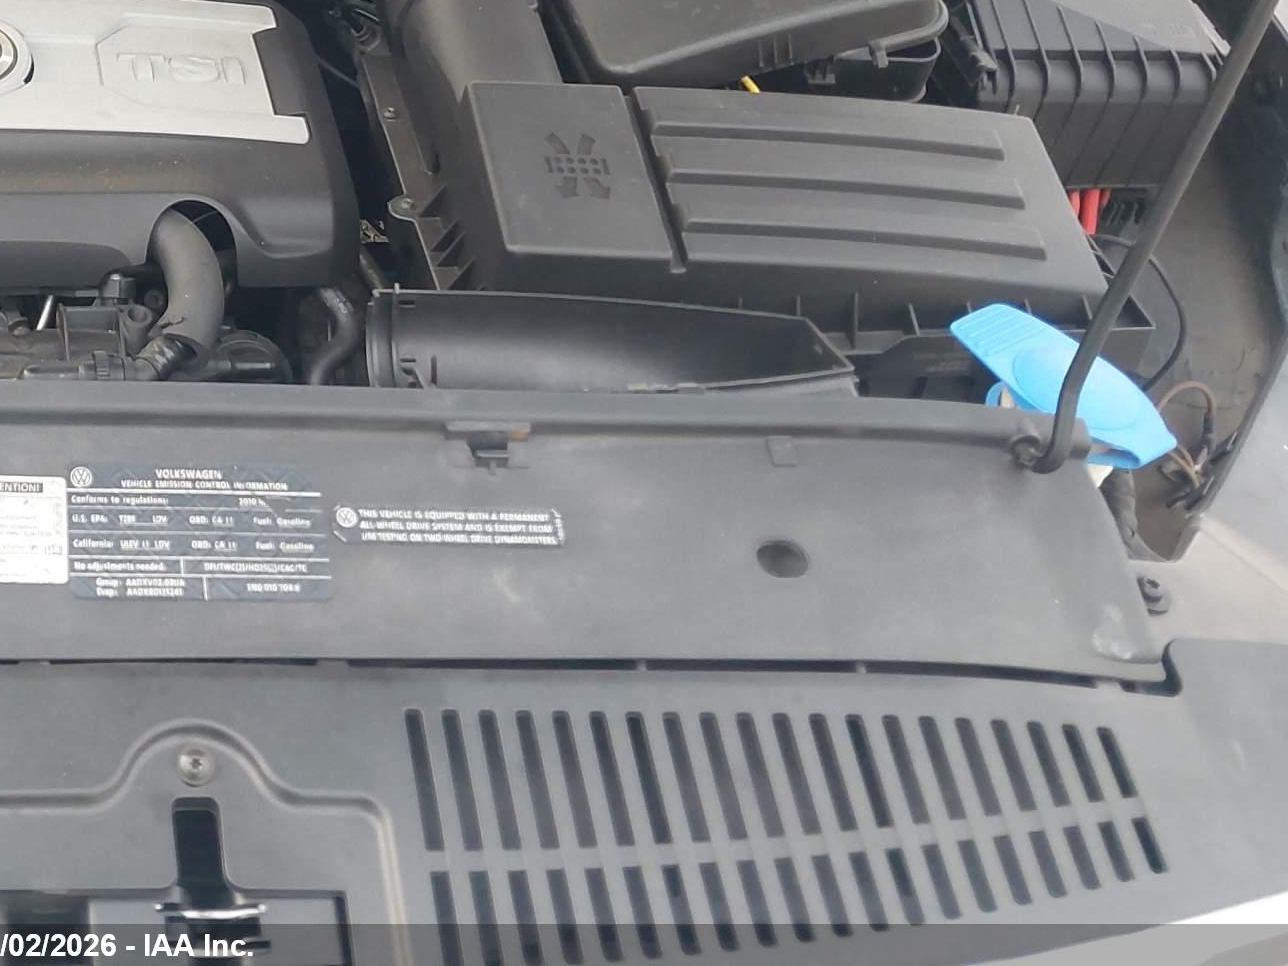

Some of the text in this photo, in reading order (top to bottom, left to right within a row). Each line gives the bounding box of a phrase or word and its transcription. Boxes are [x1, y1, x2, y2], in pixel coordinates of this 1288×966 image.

[116, 52, 248, 86] TSI
[155, 468, 223, 480] VOLKSWAGEN
[120, 479, 152, 488] VEHICLE
[155, 480, 193, 489] EMISSION
[195, 480, 230, 490] CONTROL
[71, 494, 108, 504] Conforms
[110, 495, 120, 504] to
